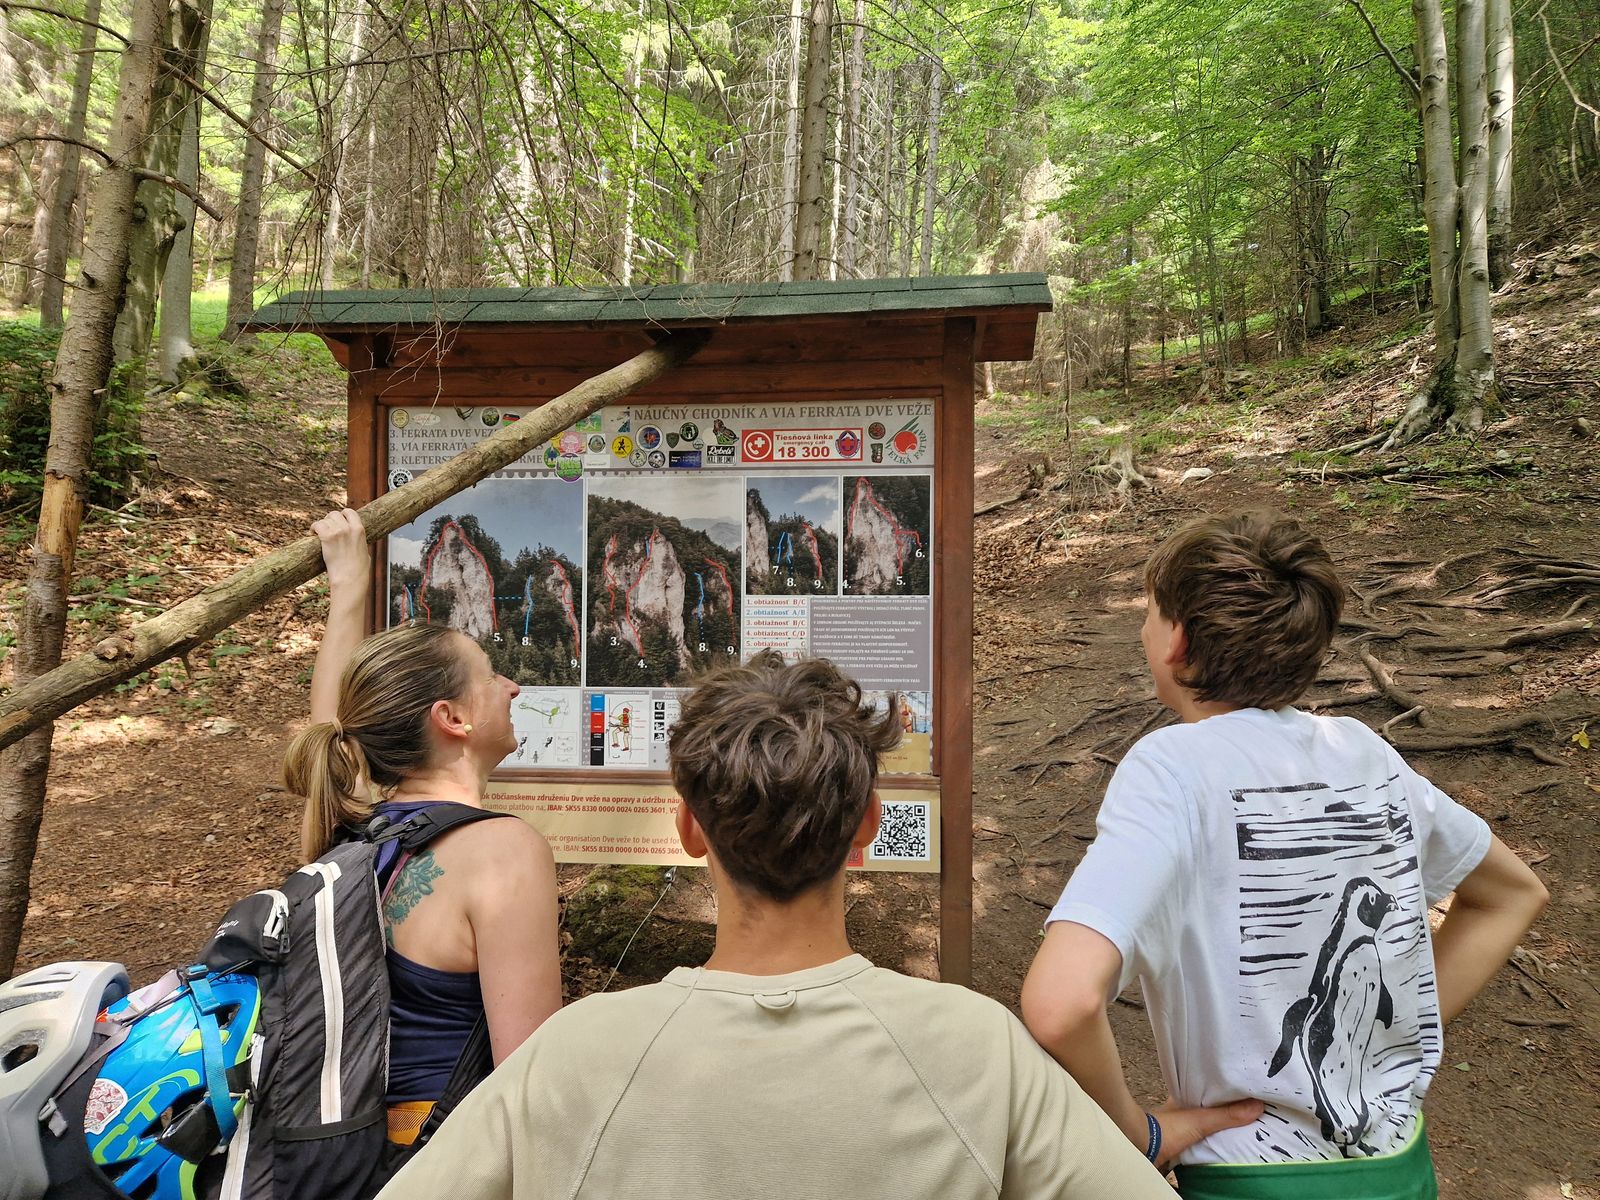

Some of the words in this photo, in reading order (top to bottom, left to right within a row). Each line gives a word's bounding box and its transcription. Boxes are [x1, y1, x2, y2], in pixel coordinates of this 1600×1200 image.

[634, 406, 688, 420] NÁUČNÝ
[692, 405, 757, 419] CHODNÍK
[759, 408, 768, 418] A
[773, 407, 795, 418] VIA
[800, 406, 861, 418] FERRATA
[865, 405, 893, 417] DVE
[897, 402, 932, 416] VEŽE
[390, 430, 398, 438] 3.
[401, 429, 448, 438] FERRATA
[450, 429, 471, 438] DVE
[390, 443, 398, 451] 3.
[422, 442, 468, 451] FERRATA
[778, 446, 796, 458] 18
[802, 446, 830, 457] 300
[915, 549, 925, 558] 6.
[772, 566, 782, 575] 7.
[787, 578, 797, 587] 8.
[814, 580, 824, 589] 9.
[842, 579, 851, 588] 4.
[896, 577, 906, 585] 5.
[494, 633, 503, 642] 5.
[522, 637, 532, 646] 8.
[610, 637, 620, 646] 3.
[699, 643, 709, 652] 8.
[727, 646, 737, 655] 9.
[571, 659, 580, 668] 9.
[637, 659, 647, 668] 4.
[559, 834, 601, 843] organisation
